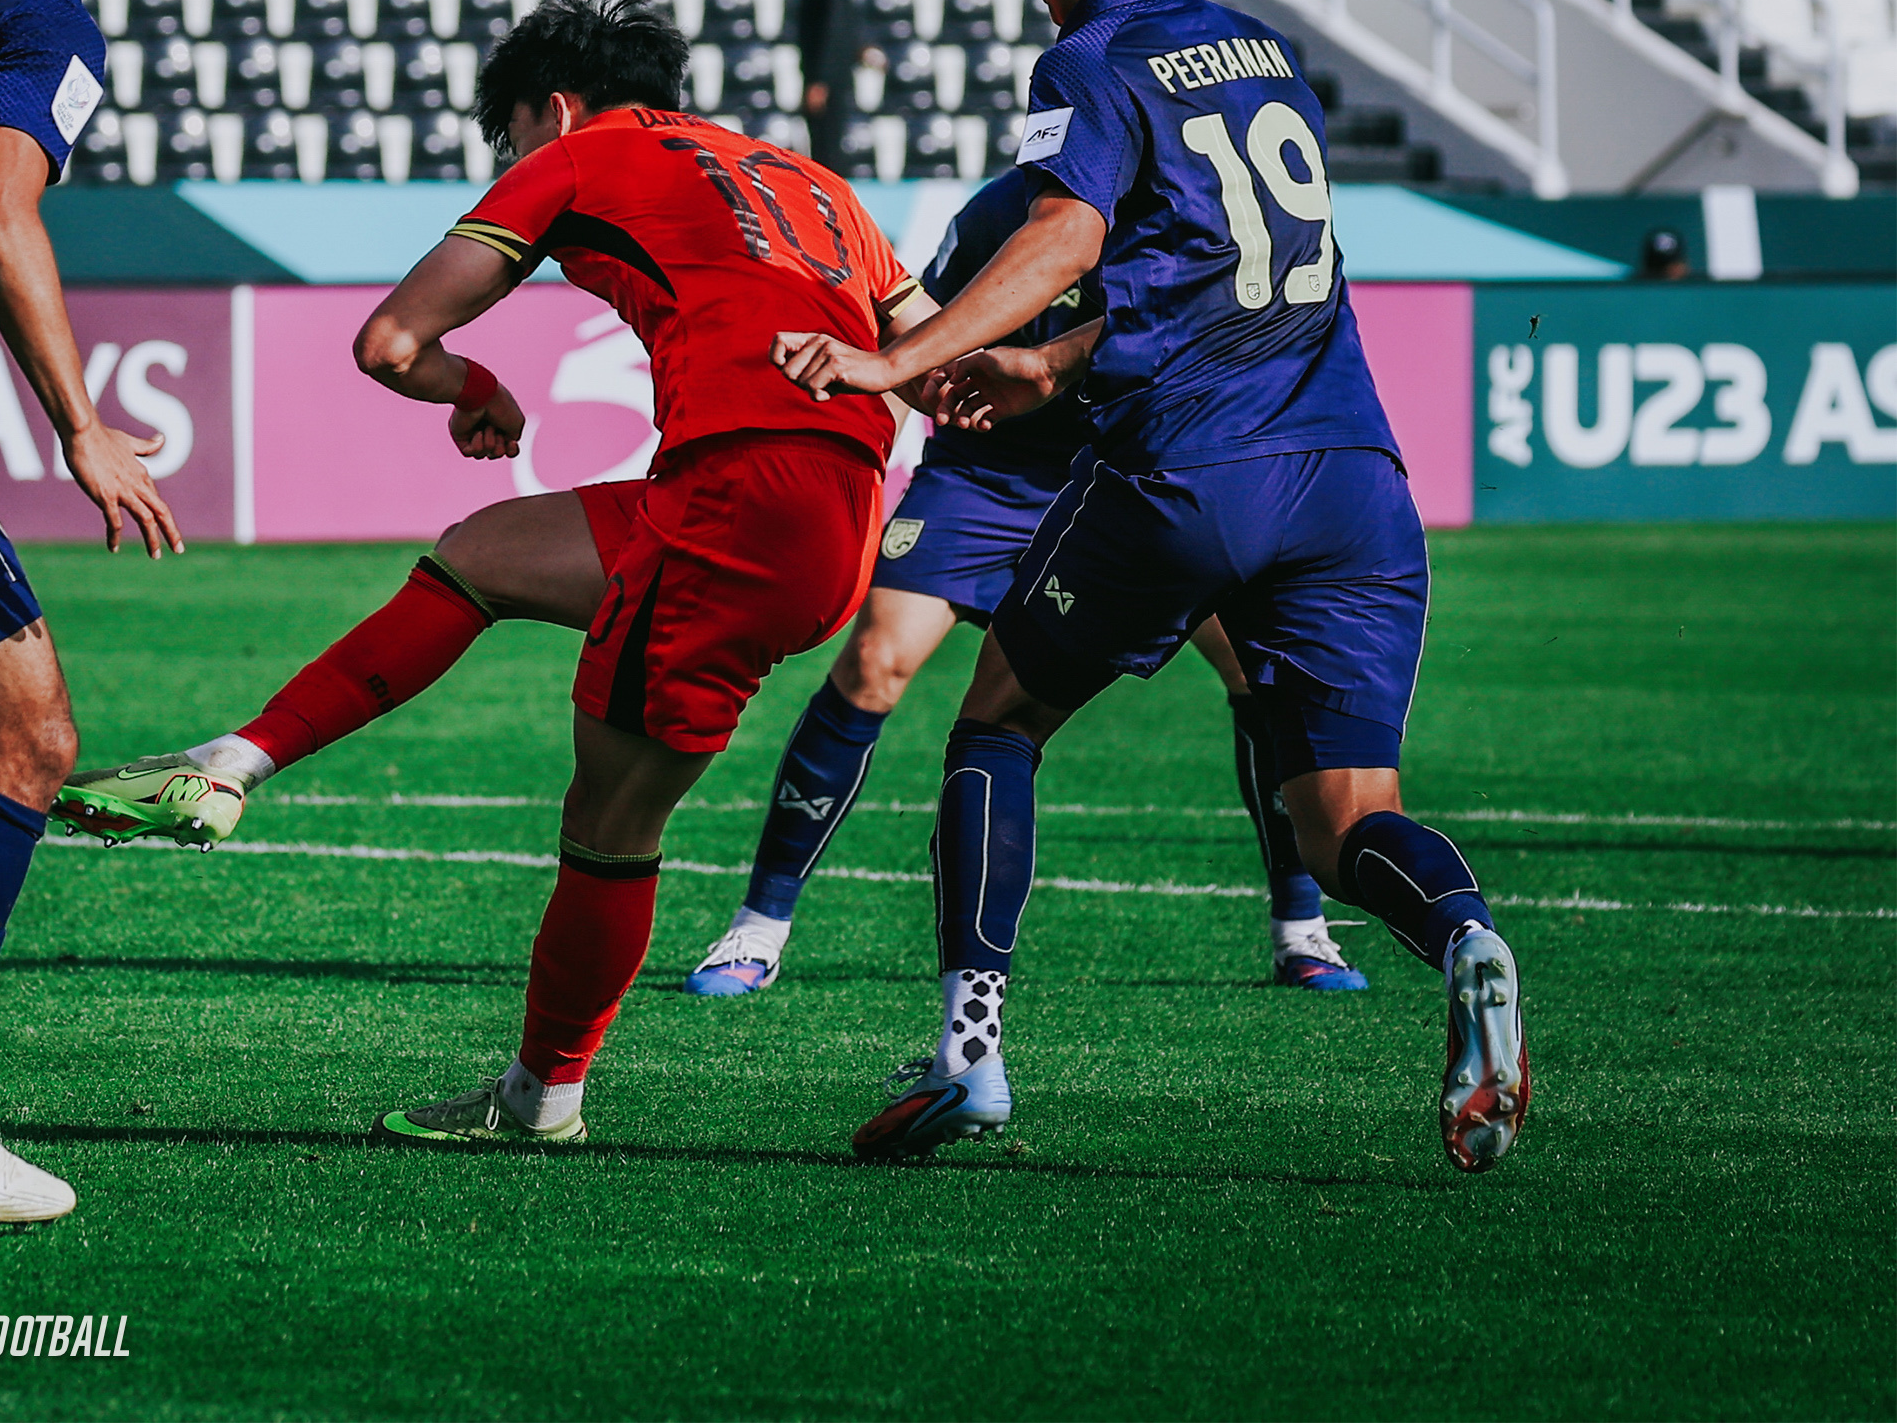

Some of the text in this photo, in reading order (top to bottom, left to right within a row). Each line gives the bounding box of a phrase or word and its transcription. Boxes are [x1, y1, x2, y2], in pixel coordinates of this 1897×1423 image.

[1147, 37, 1294, 94] PEERANAN
[1026, 124, 1062, 143] AFC
[659, 137, 853, 288] 10
[1182, 101, 1335, 310] 19
[1487, 343, 1534, 468] AFC
[1542, 341, 1773, 469] U23
